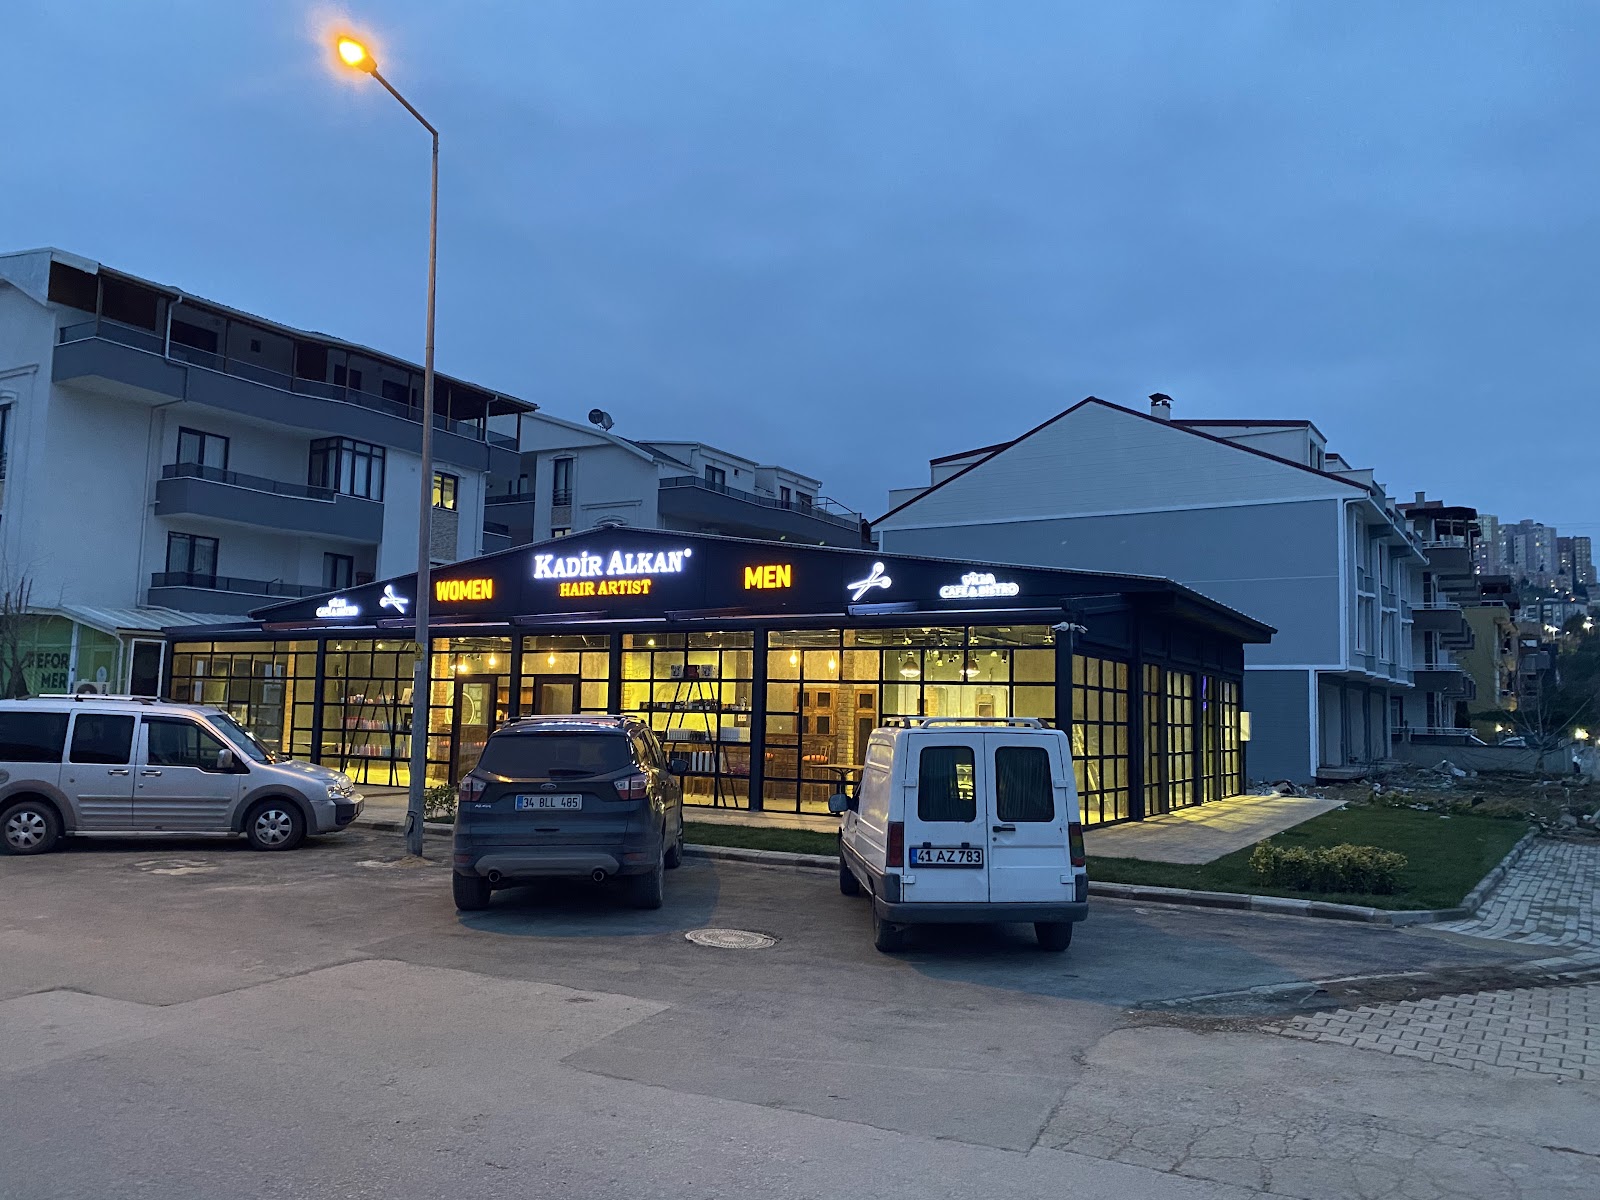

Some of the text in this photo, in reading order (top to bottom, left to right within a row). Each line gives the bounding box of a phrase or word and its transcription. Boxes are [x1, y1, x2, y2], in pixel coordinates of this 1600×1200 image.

[744, 564, 791, 590] MEN
[436, 578, 493, 601] WOMEN
[559, 579, 652, 597] HAIR ARTIST
[41, 672, 67, 689] MER
[523, 797, 578, 808] 34 BLL 485
[918, 850, 981, 863] 41 AZ 783
